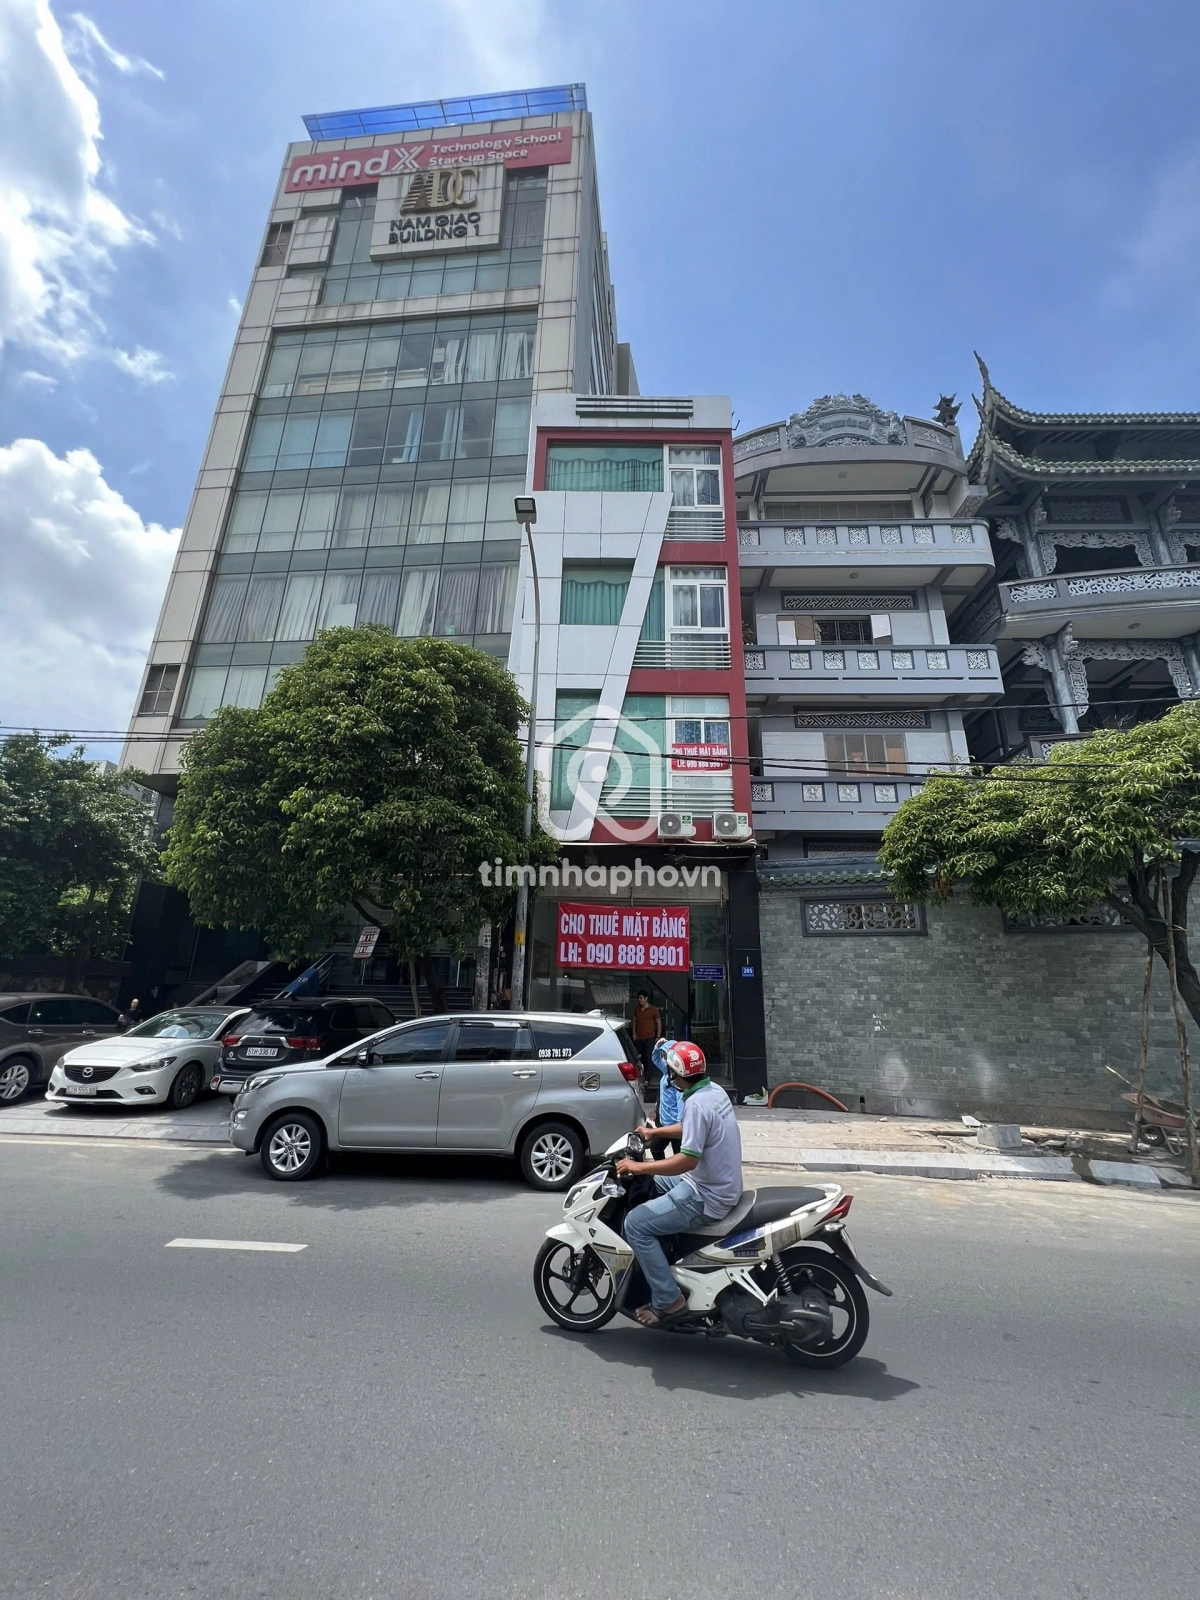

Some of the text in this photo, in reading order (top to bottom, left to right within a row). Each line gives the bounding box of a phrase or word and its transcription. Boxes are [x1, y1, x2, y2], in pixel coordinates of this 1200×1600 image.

[432, 131, 562, 154] Technology School
[292, 145, 425, 185] mindX
[429, 148, 528, 167] Start-up Space
[390, 211, 481, 231] NAM GIAO
[389, 223, 480, 244] BUILDING 1
[560, 909, 686, 941] CHO THUÊ MẶT BẰNG
[560, 941, 684, 966] LH: 090 888 9901
[538, 1047, 572, 1058] 0938 791 973
